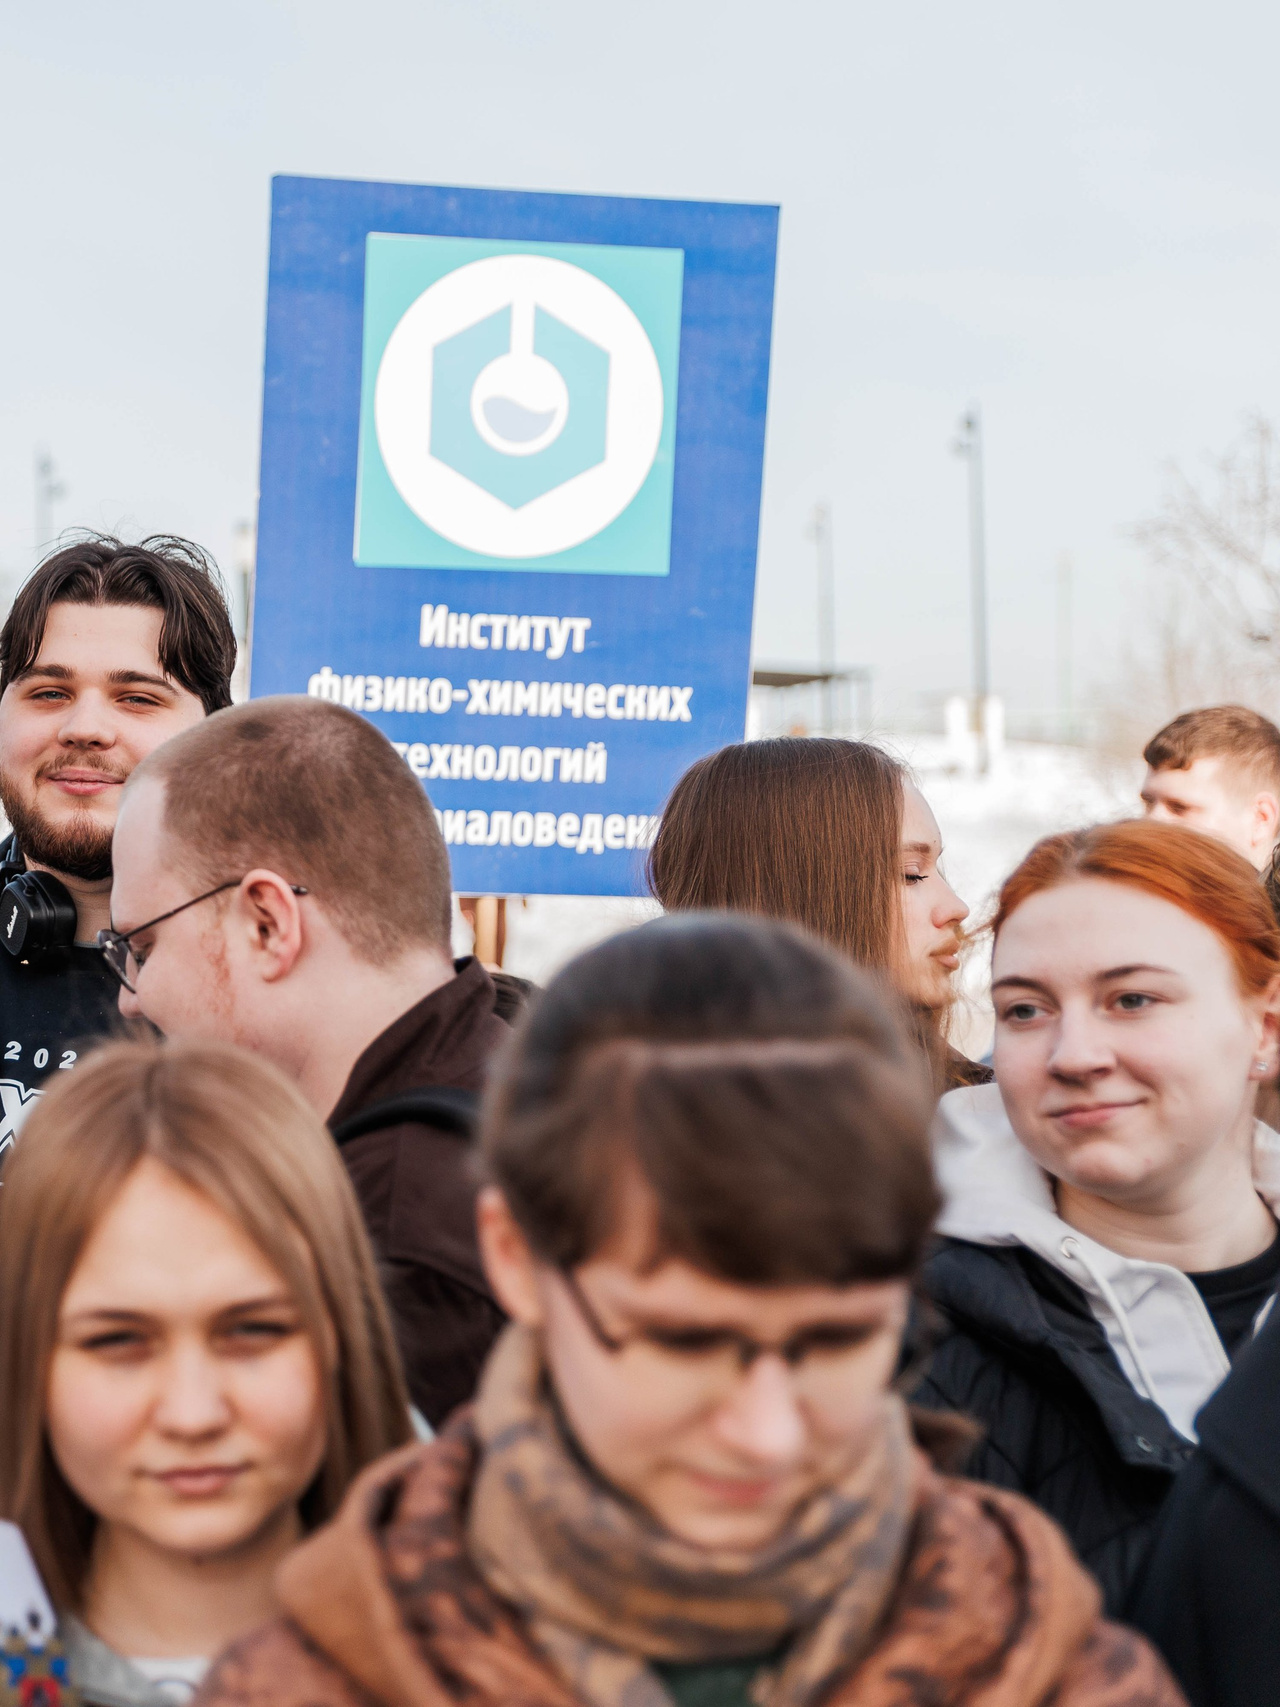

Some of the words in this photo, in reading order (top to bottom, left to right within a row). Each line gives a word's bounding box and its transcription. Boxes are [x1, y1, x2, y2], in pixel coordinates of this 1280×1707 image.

[419, 603, 592, 660] Институт
[307, 666, 693, 723] физико-химических
[433, 808, 660, 855] иаловеден
